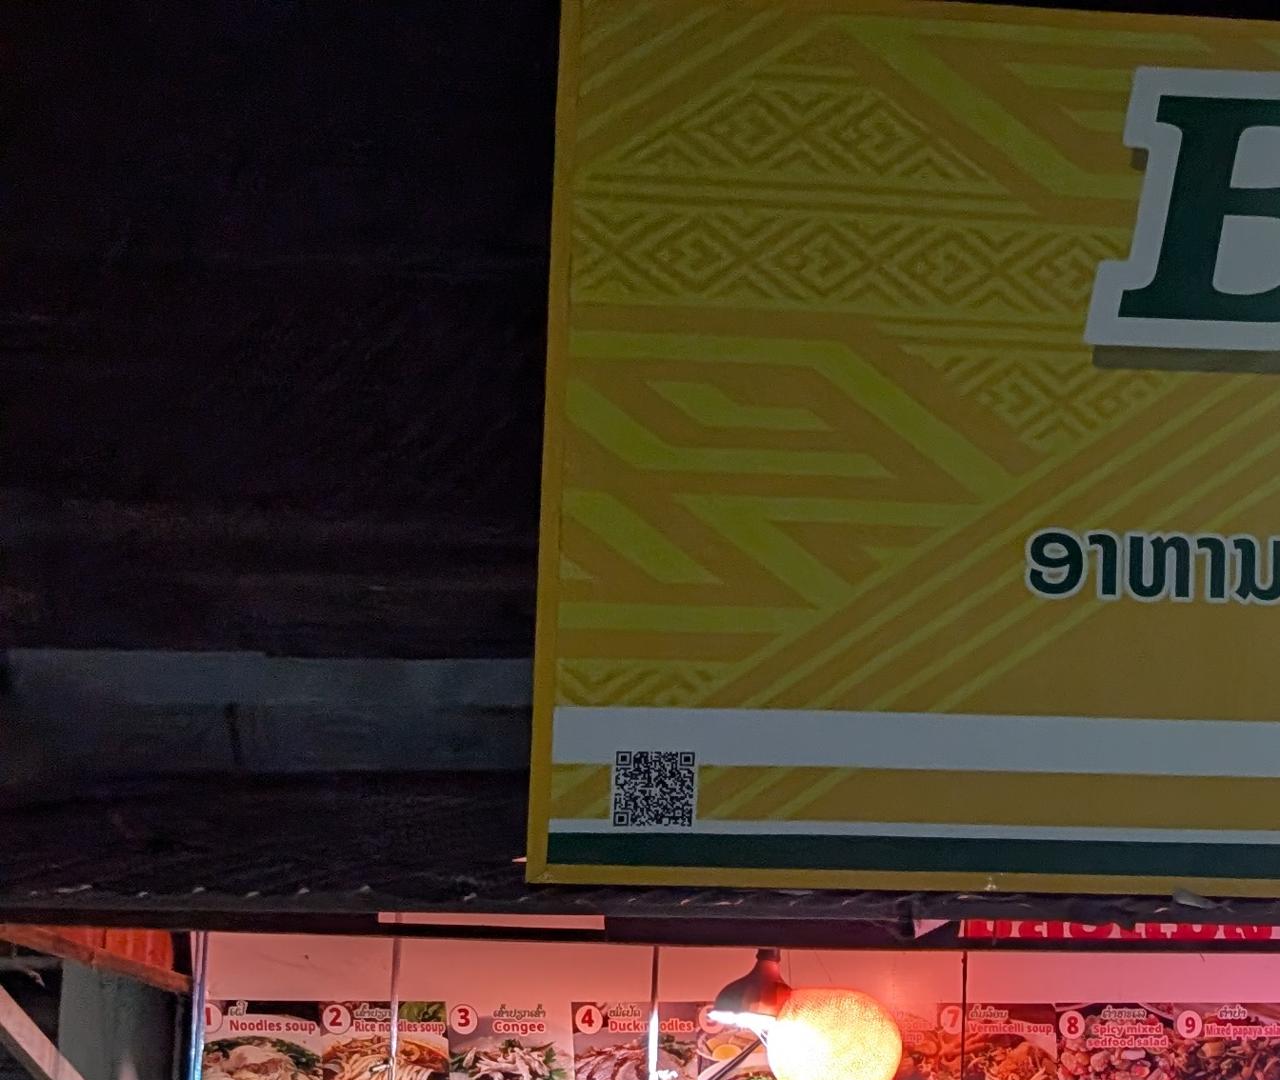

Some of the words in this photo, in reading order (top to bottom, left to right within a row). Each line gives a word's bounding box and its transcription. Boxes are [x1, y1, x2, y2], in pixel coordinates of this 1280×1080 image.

[328, 1007, 343, 1027] 2
[457, 1007, 471, 1027] 3
[580, 1007, 595, 1028] 4
[949, 1007, 960, 1028] 7
[1184, 1016, 1196, 1034] 9
[229, 1019, 282, 1032] Noodles
[284, 1021, 317, 1035] soup
[354, 1020, 377, 1032] Rice
[379, 1020, 418, 1033] nodles
[420, 1021, 446, 1036] soup
[493, 1020, 546, 1036] Congee
[609, 1019, 640, 1032] Duck
[970, 1023, 1025, 1034] Vermicelli
[1027, 1023, 1053, 1037] soup
[1066, 1017, 1079, 1035] 8
[1093, 1023, 1124, 1037] Spicy
[1126, 1023, 1163, 1035] mixed
[1206, 1024, 1231, 1037] Mixed
[1232, 1025, 1263, 1040] papaya
[1137, 1036, 1168, 1048] salad
